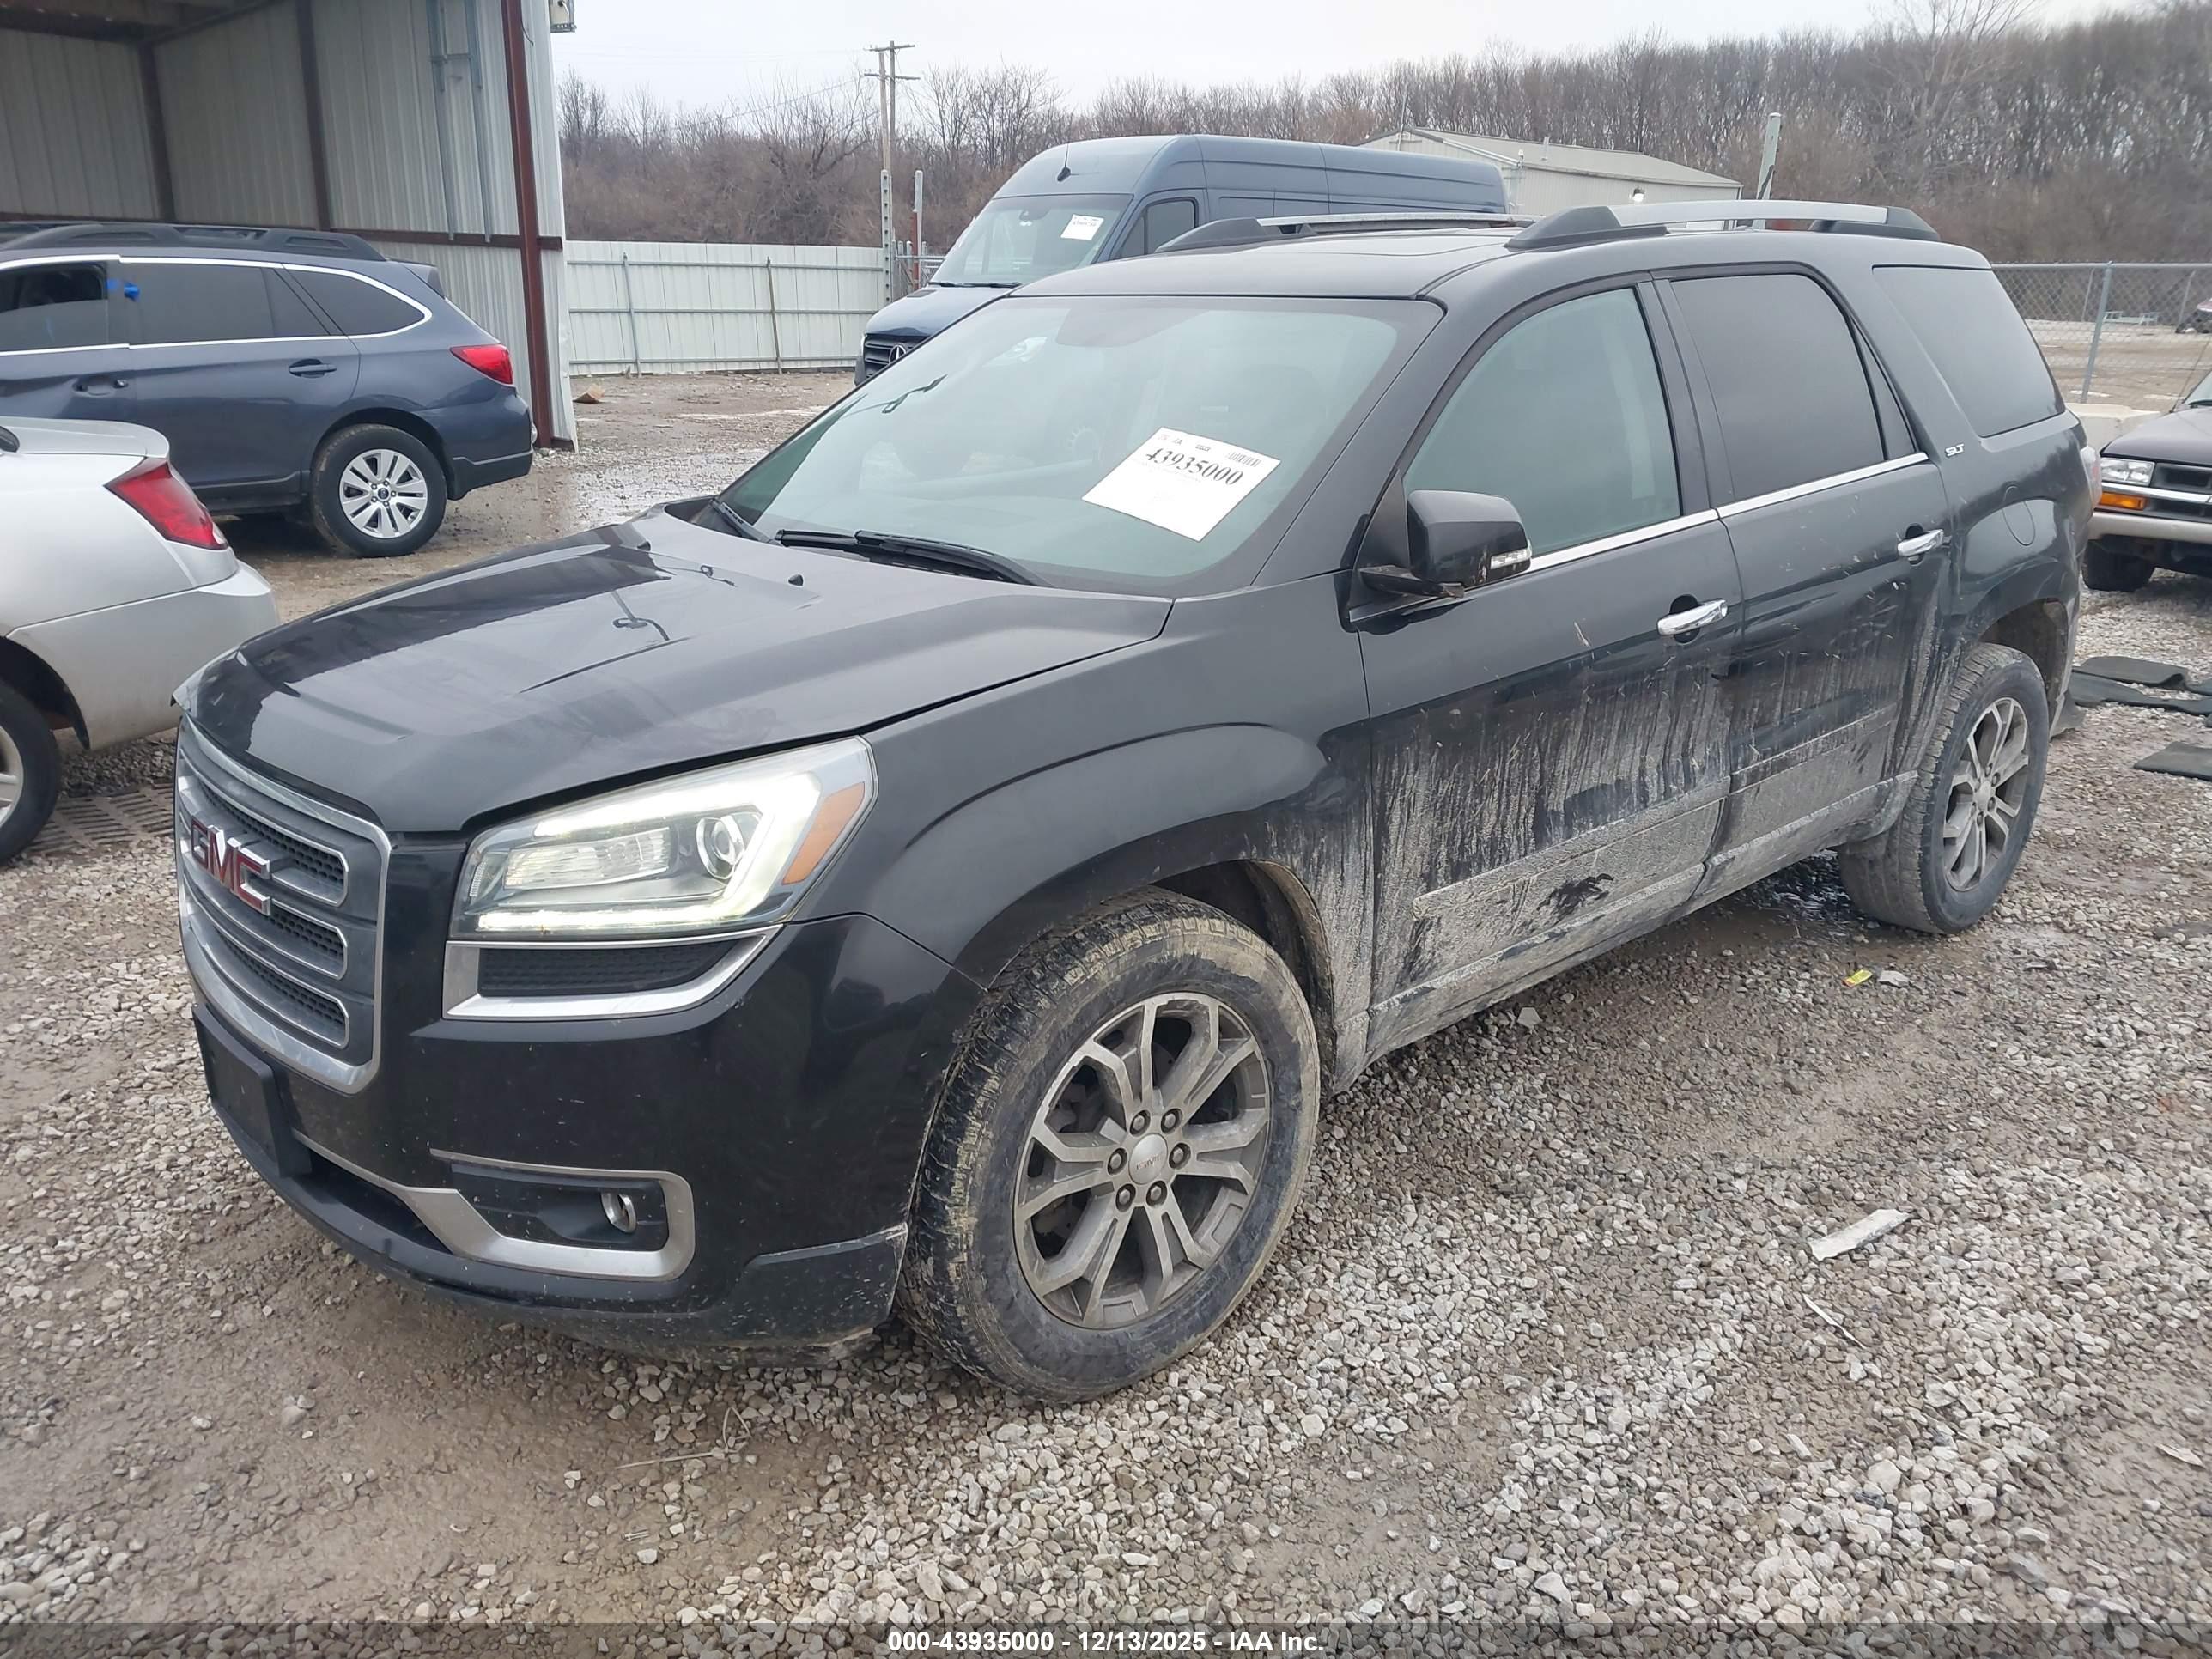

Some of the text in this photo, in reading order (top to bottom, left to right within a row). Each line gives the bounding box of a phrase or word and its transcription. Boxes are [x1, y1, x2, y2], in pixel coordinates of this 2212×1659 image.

[1146, 447, 1243, 485] 43935000
[1945, 443, 1965, 456] SLT
[191, 815, 270, 915] GMC
